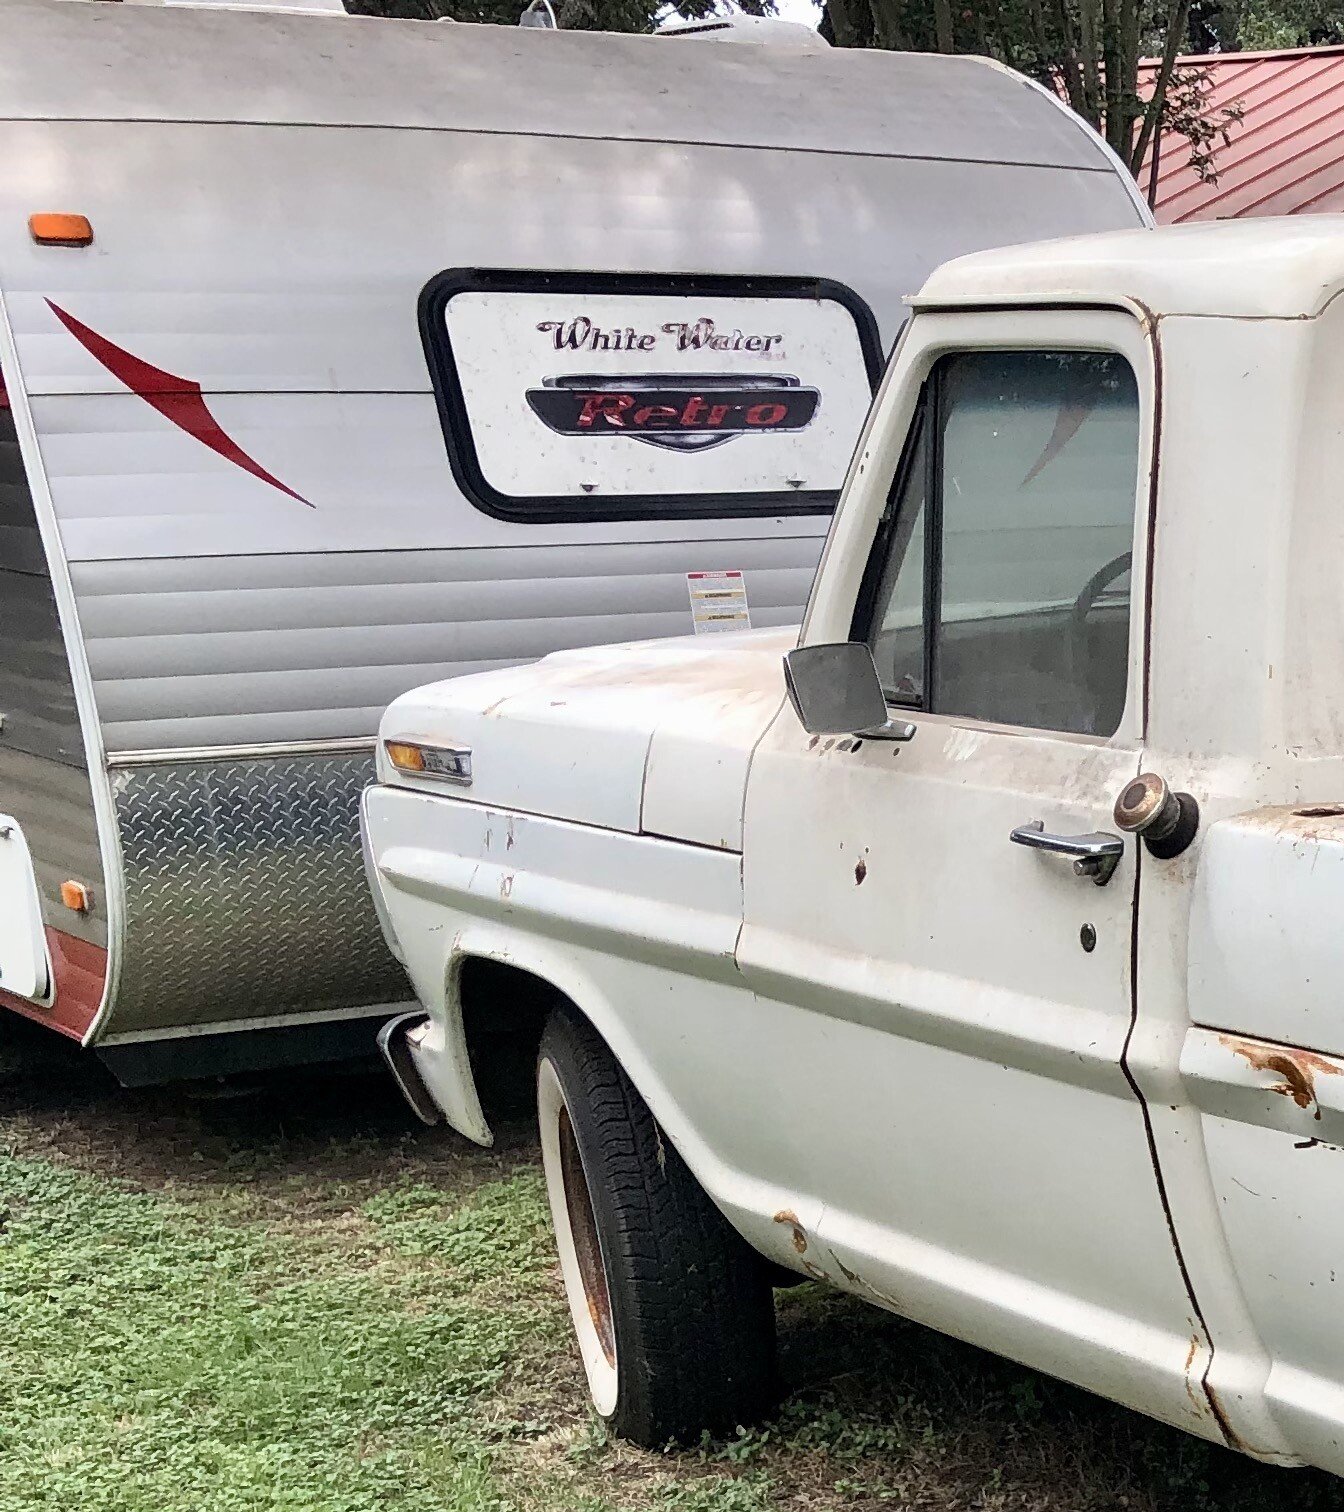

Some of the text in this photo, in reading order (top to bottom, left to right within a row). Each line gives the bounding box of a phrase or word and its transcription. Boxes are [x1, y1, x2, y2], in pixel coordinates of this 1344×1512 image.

[536, 316, 783, 352] White Water
[573, 392, 789, 428] Retro
